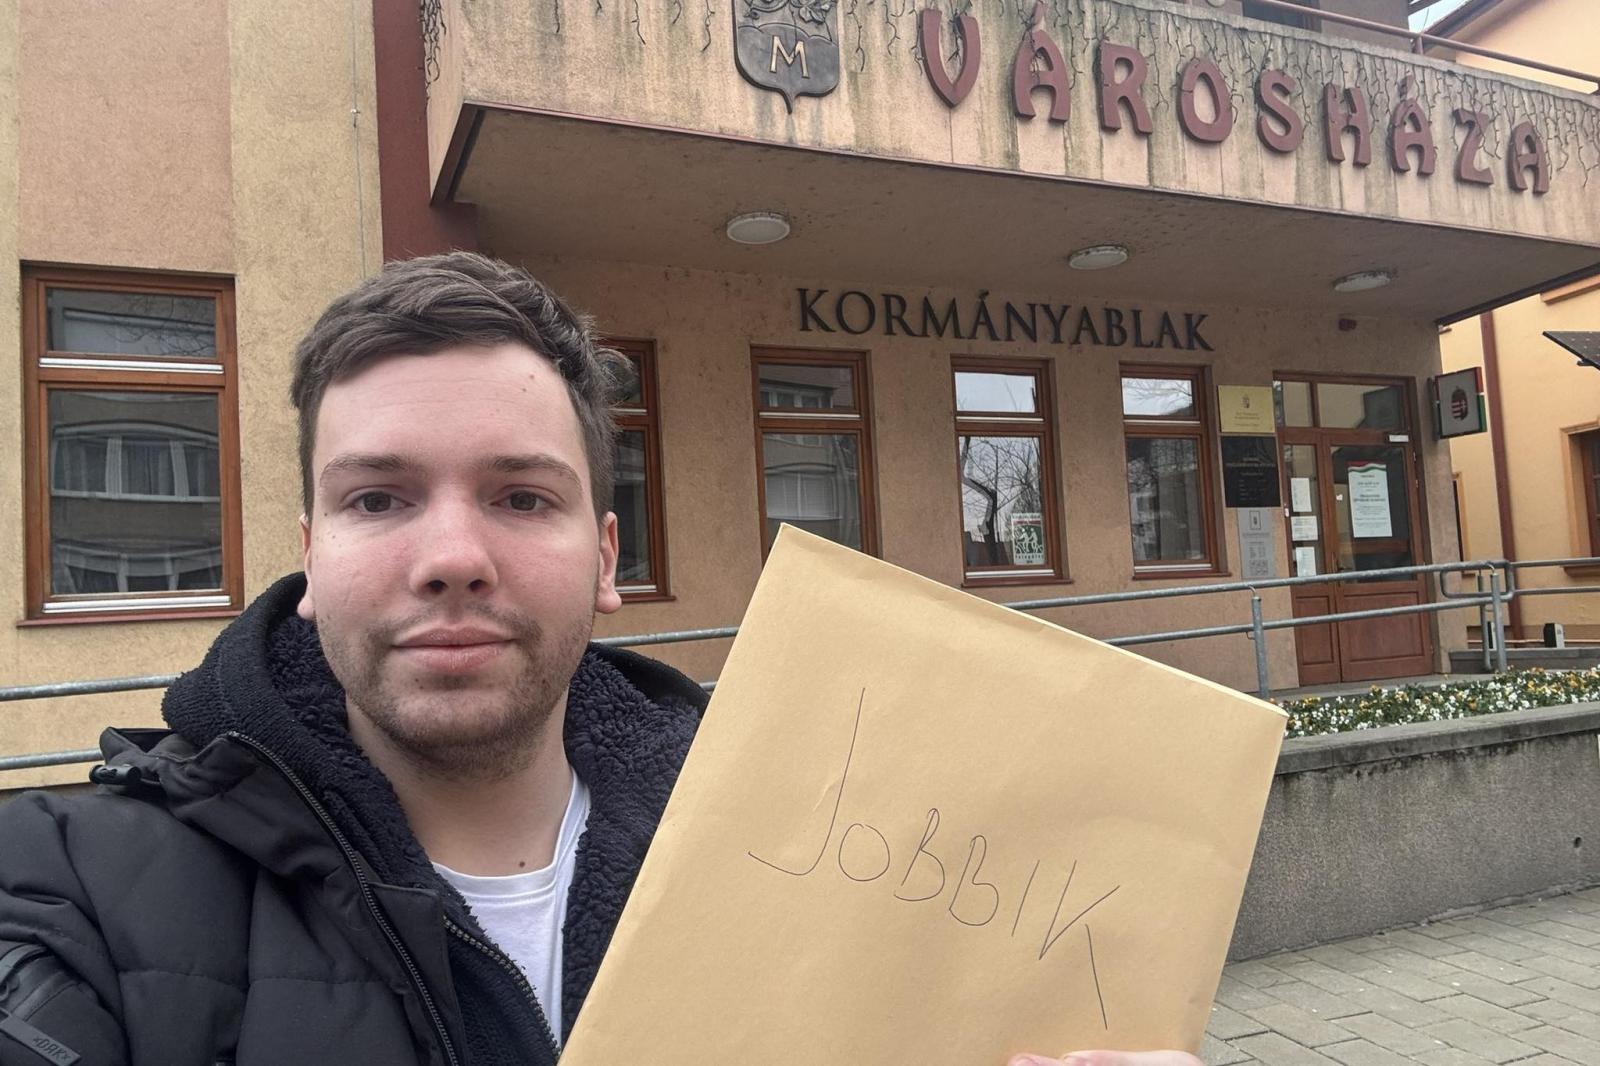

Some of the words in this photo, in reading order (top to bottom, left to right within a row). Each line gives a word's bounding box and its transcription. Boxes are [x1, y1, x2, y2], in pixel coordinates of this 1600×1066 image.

[769, 35, 810, 79] M
[920, 0, 1549, 194] VÁROSHÁZA
[797, 287, 1215, 351] KORMÁNYABLAK
[748, 687, 1121, 1030] JOBBIK
